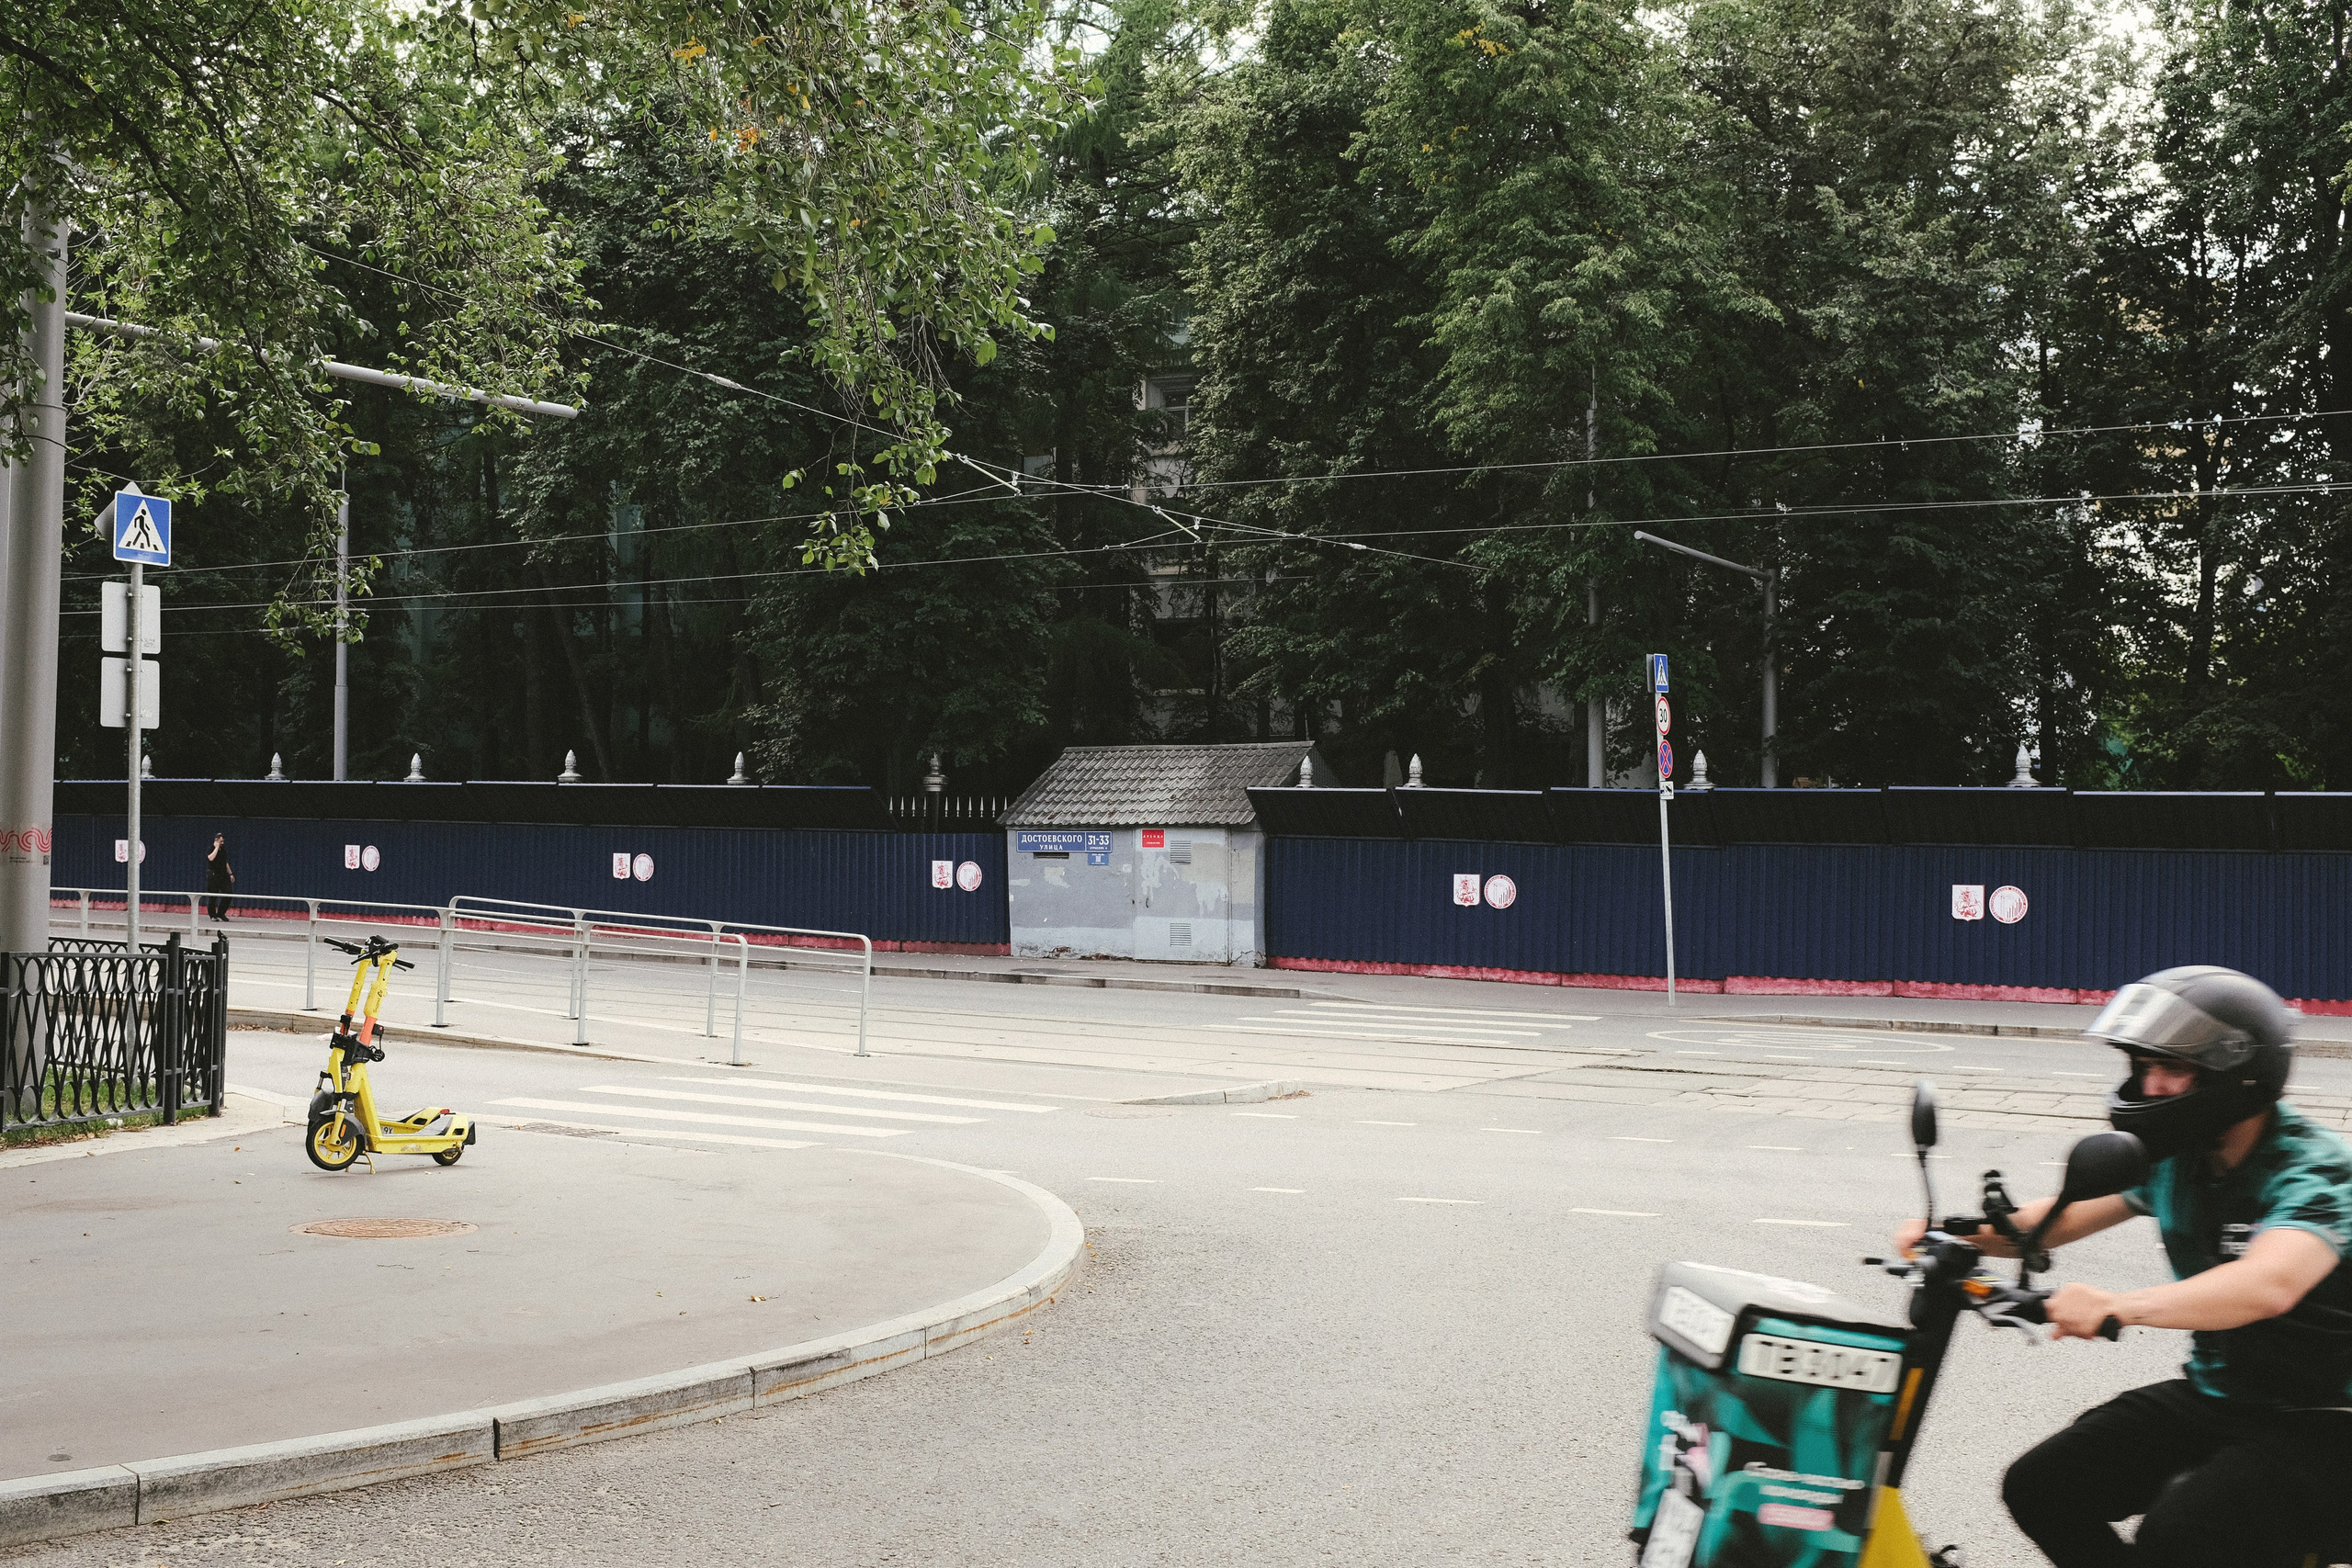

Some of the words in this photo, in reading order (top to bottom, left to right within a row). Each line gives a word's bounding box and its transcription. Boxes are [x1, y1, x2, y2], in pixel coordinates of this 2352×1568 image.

[1659, 708, 1668, 723] 30
[1021, 834, 1083, 843] ДОСТОЕВСКОГО
[1088, 835, 1110, 845] 31-33
